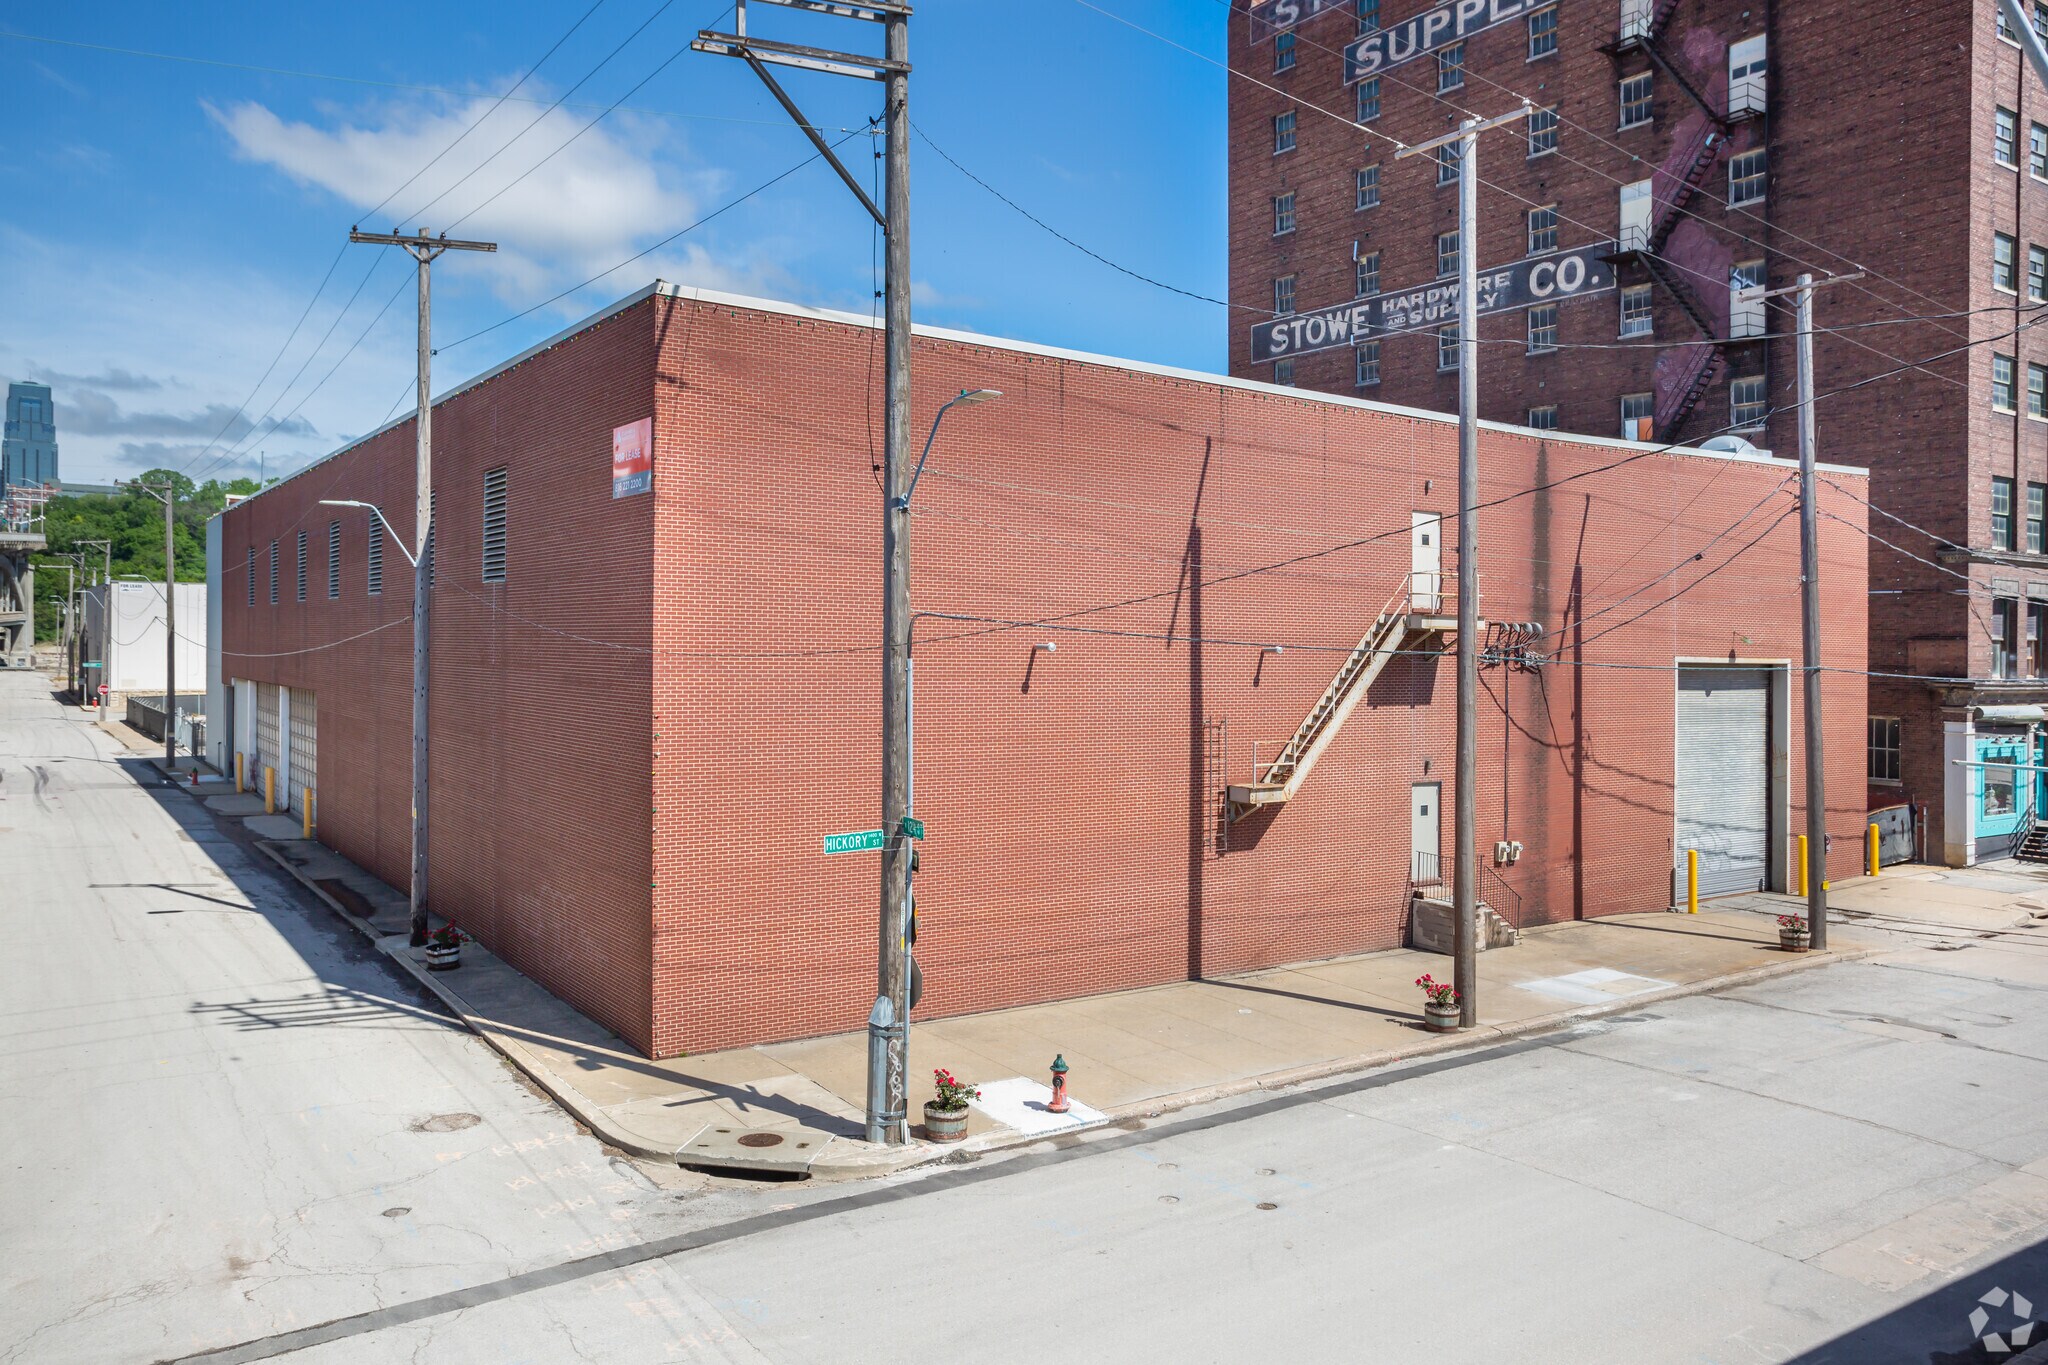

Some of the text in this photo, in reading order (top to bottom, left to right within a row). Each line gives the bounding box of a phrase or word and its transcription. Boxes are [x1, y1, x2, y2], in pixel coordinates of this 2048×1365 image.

[1355, 0, 1537, 75] SUPPL
[1382, 271, 1513, 313] HARDWRE
[1529, 256, 1599, 297] CO.
[1270, 304, 1370, 353] STOWE
[1388, 292, 1498, 325] AND SUPY
[626, 448, 640, 460] LEASE
[826, 835, 880, 851] HICKORY ST
